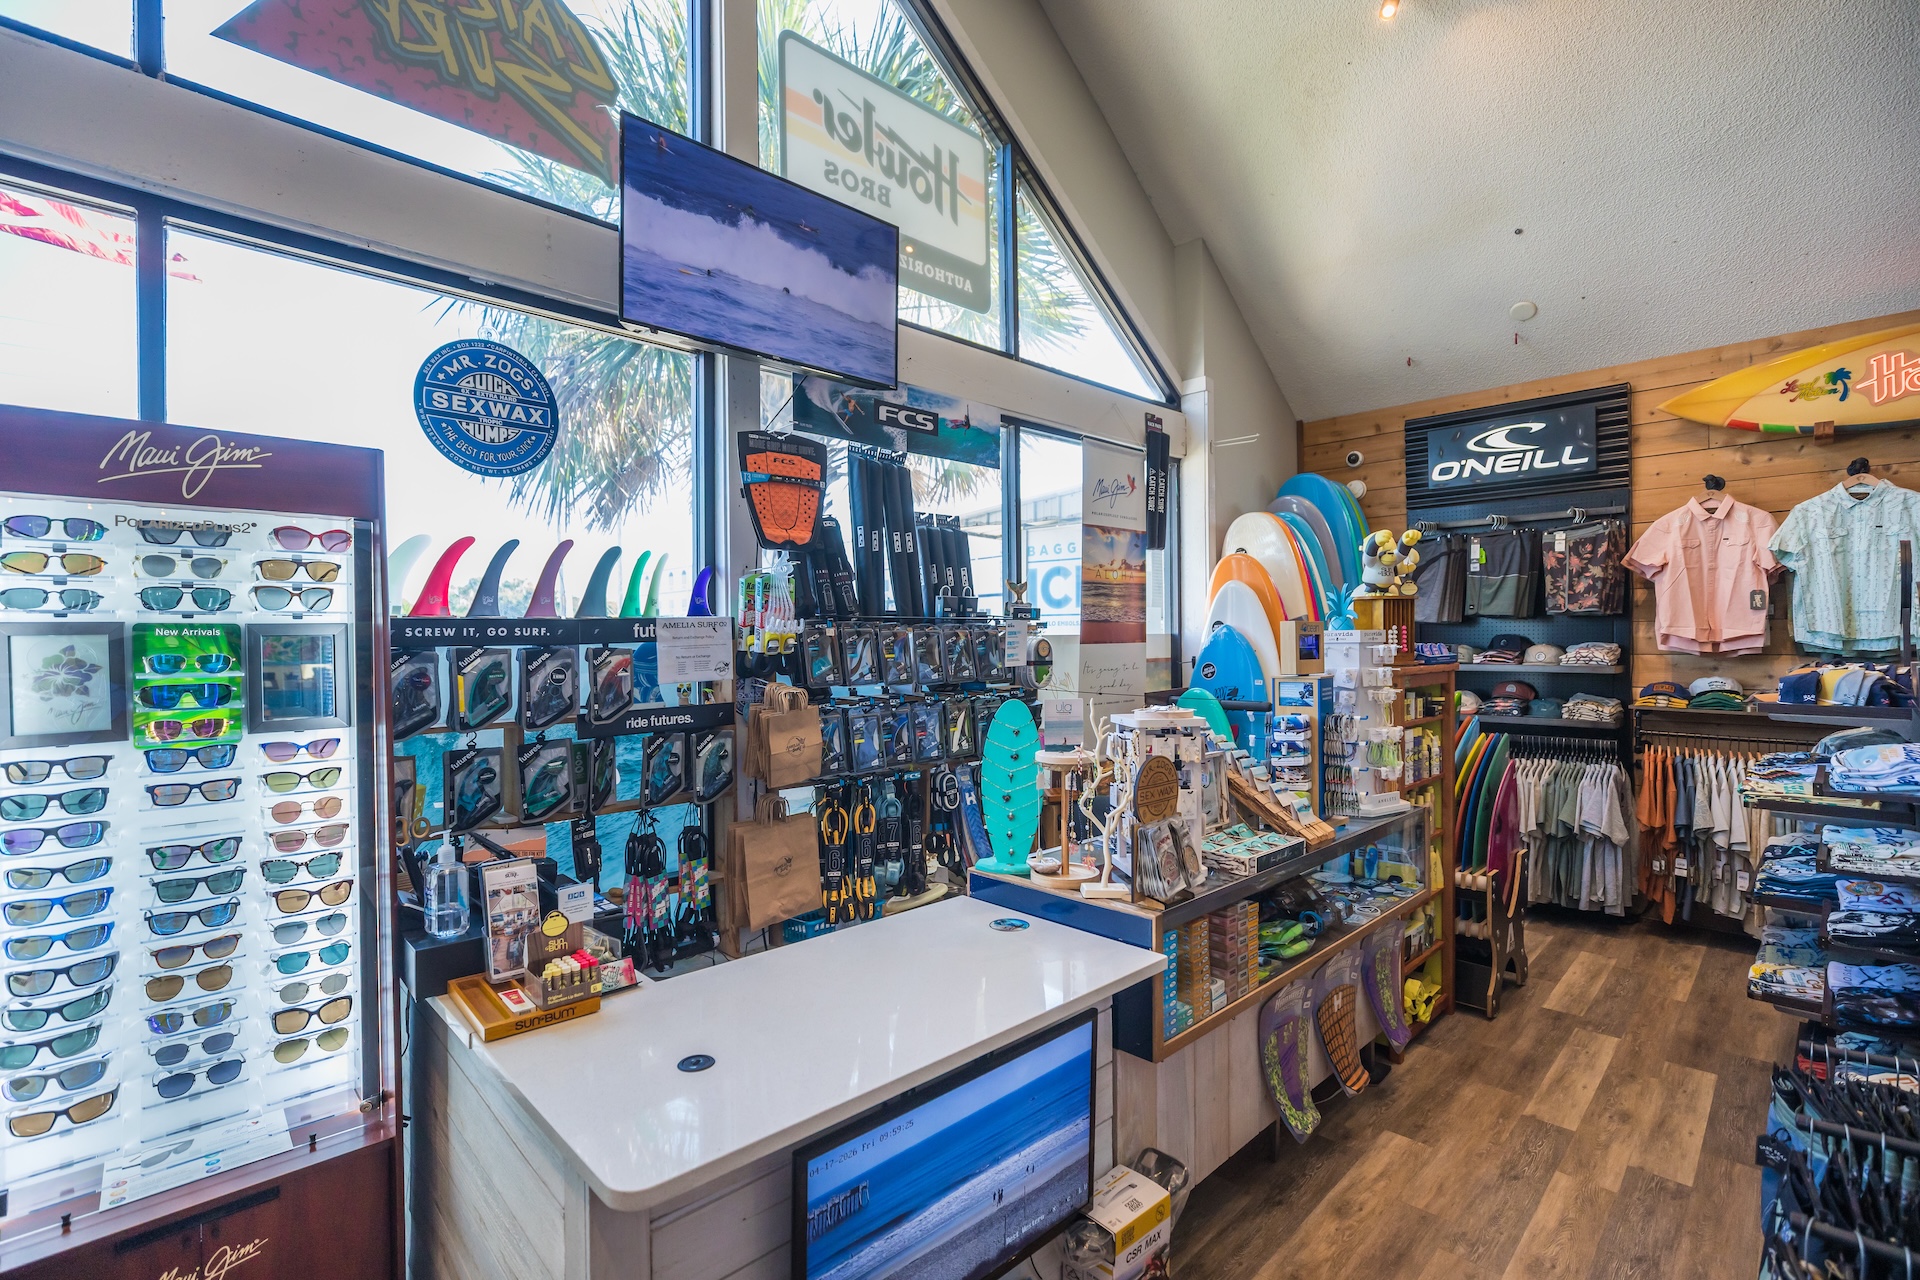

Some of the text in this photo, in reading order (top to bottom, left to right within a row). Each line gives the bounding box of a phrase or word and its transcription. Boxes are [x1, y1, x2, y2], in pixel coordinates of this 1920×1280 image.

[423, 362, 432, 374] SEX
[430, 354, 442, 364] WAX
[442, 354, 534, 391] MR. ZOGS
[458, 374, 519, 397] QUICK
[476, 391, 498, 400] EXTRA
[500, 395, 518, 403] HARD
[432, 391, 544, 425] SEXWAX
[878, 405, 934, 431] FCS
[479, 417, 503, 426] TROPIC
[461, 421, 519, 443] HUMPS
[445, 426, 533, 463] THE BEST FOR YOUR STICK
[99, 430, 272, 499] Maui Jim
[773, 457, 795, 465] FCS
[1431, 446, 1589, 481] O'NEILL
[743, 472, 752, 482] T3
[1092, 478, 1130, 509] Maui Jim
[1147, 476, 1156, 512] CATCH SURF
[1158, 478, 1166, 497] CATCH
[1095, 569, 1134, 580] ALOHA
[155, 628, 221, 637] New Arrivals
[404, 627, 551, 638] SCREW IT, GO SURF.
[697, 621, 718, 631] SURF
[458, 647, 485, 669] futures.
[527, 651, 551, 672] futures.
[593, 649, 611, 666] futures.
[1095, 662, 1140, 679] going to be
[1097, 679, 1133, 694] good day
[1055, 701, 1072, 712] ula
[625, 714, 694, 729] ride futures.
[697, 733, 714, 752] futures.
[450, 750, 478, 771] futures.
[518, 743, 543, 763] futures.
[904, 772, 921, 780] FCS
[1156, 760, 1173, 776] ZOGS
[1139, 787, 1175, 801] SEX WAX
[886, 822, 899, 842] 7
[861, 837, 871, 859] 6
[828, 850, 841, 872] 6
[809, 1119, 914, 1178] 04-17-2026 Fri 09:59:25
[1126, 1245, 1143, 1264] CSR
[1144, 1230, 1162, 1250] MAX
